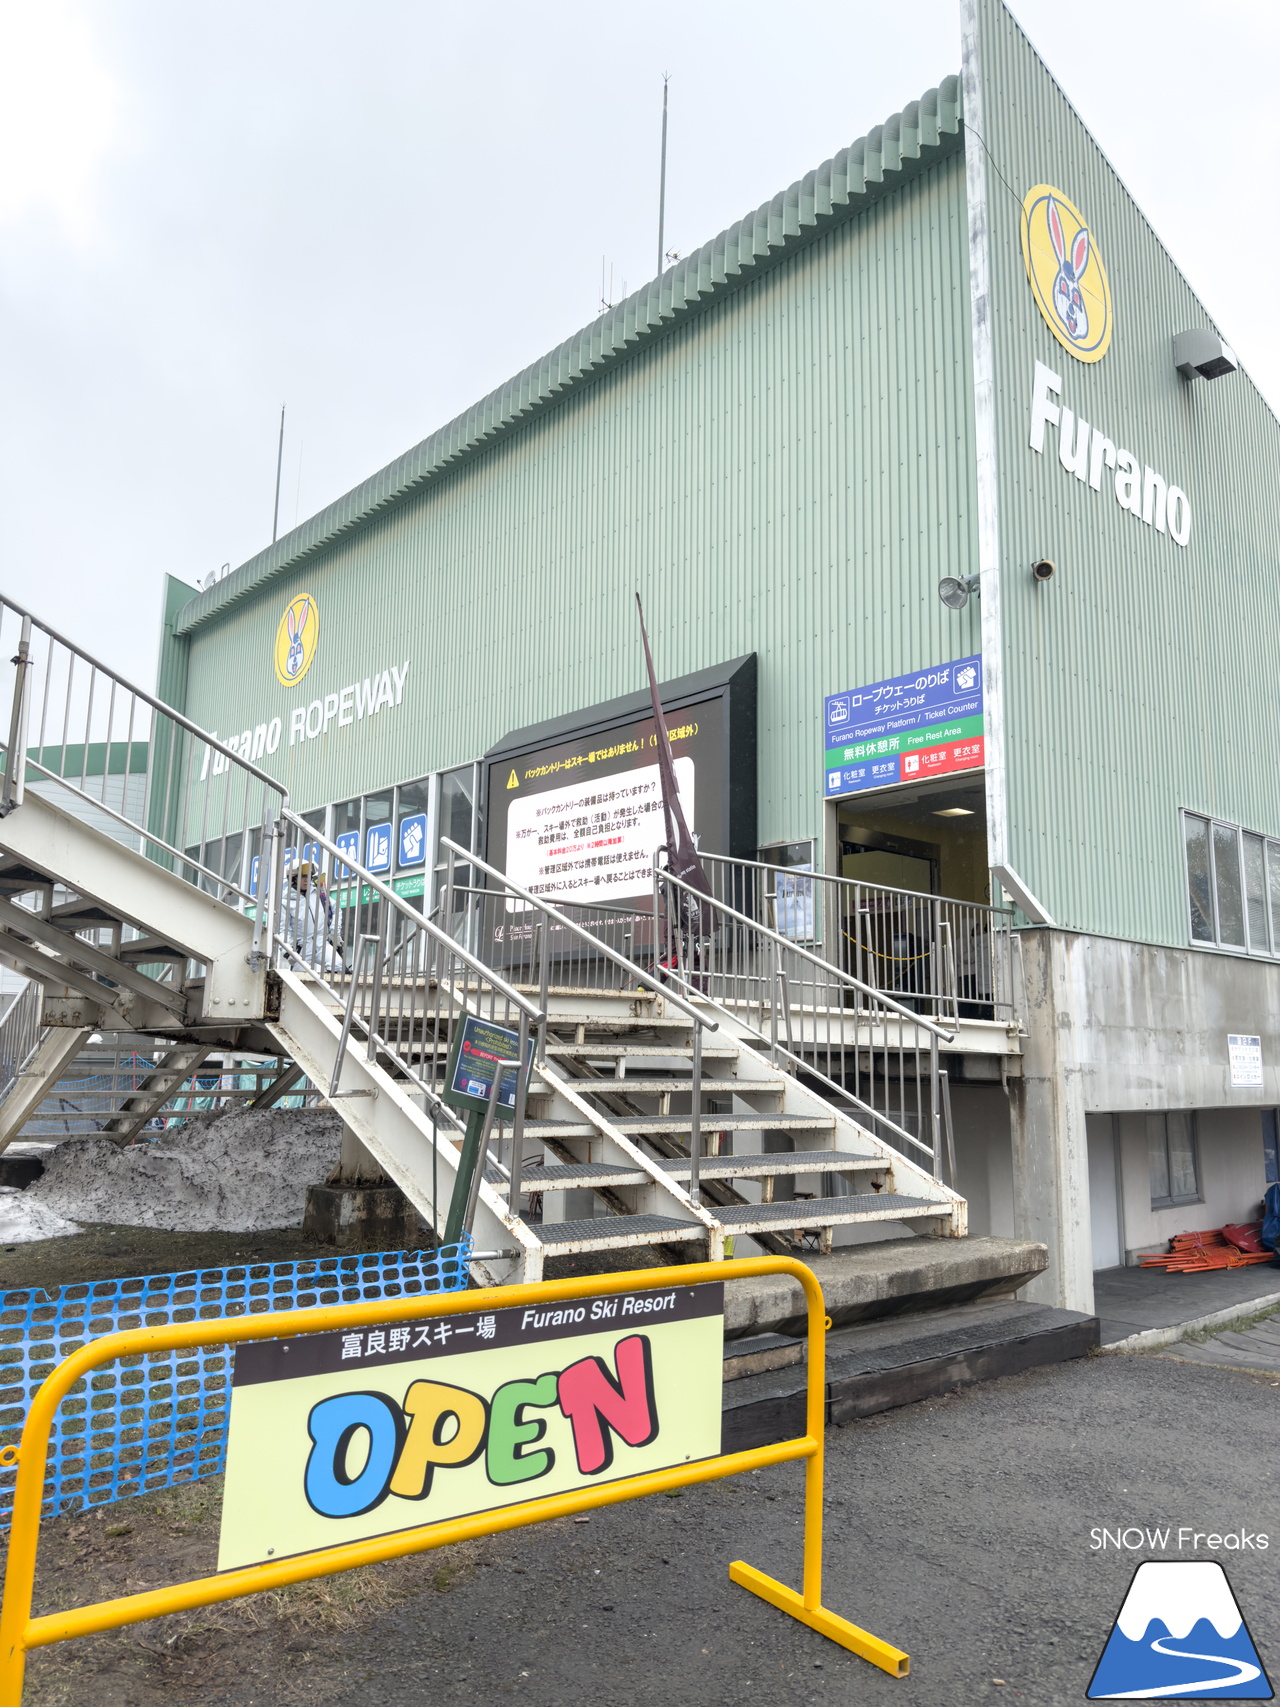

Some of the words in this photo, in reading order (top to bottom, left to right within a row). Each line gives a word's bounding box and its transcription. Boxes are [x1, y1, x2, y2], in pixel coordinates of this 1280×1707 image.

[1029, 359, 1191, 547] Furano
[289, 660, 411, 747] ROPEWAY
[852, 668, 950, 708] ロープウェーのりば
[874, 694, 926, 715] チケットうりば
[831, 731, 854, 743] Furano
[855, 724, 885, 738] Ropeway
[886, 718, 916, 731] Platform
[924, 709, 947, 721] Ticket
[948, 701, 979, 716] Counter
[907, 734, 925, 745] Free
[925, 730, 944, 741] Rest
[943, 726, 962, 737] Area
[524, 722, 699, 780] バックカントリーはスキー場ではありません！（区域外）
[843, 736, 900, 761] 無料休憩所
[340, 1314, 497, 1361] 富良野スキー場
[520, 1305, 587, 1331] Furano
[590, 1299, 619, 1319] Ski
[621, 1292, 677, 1316] Resort
[303, 1333, 660, 1520] OPEN
